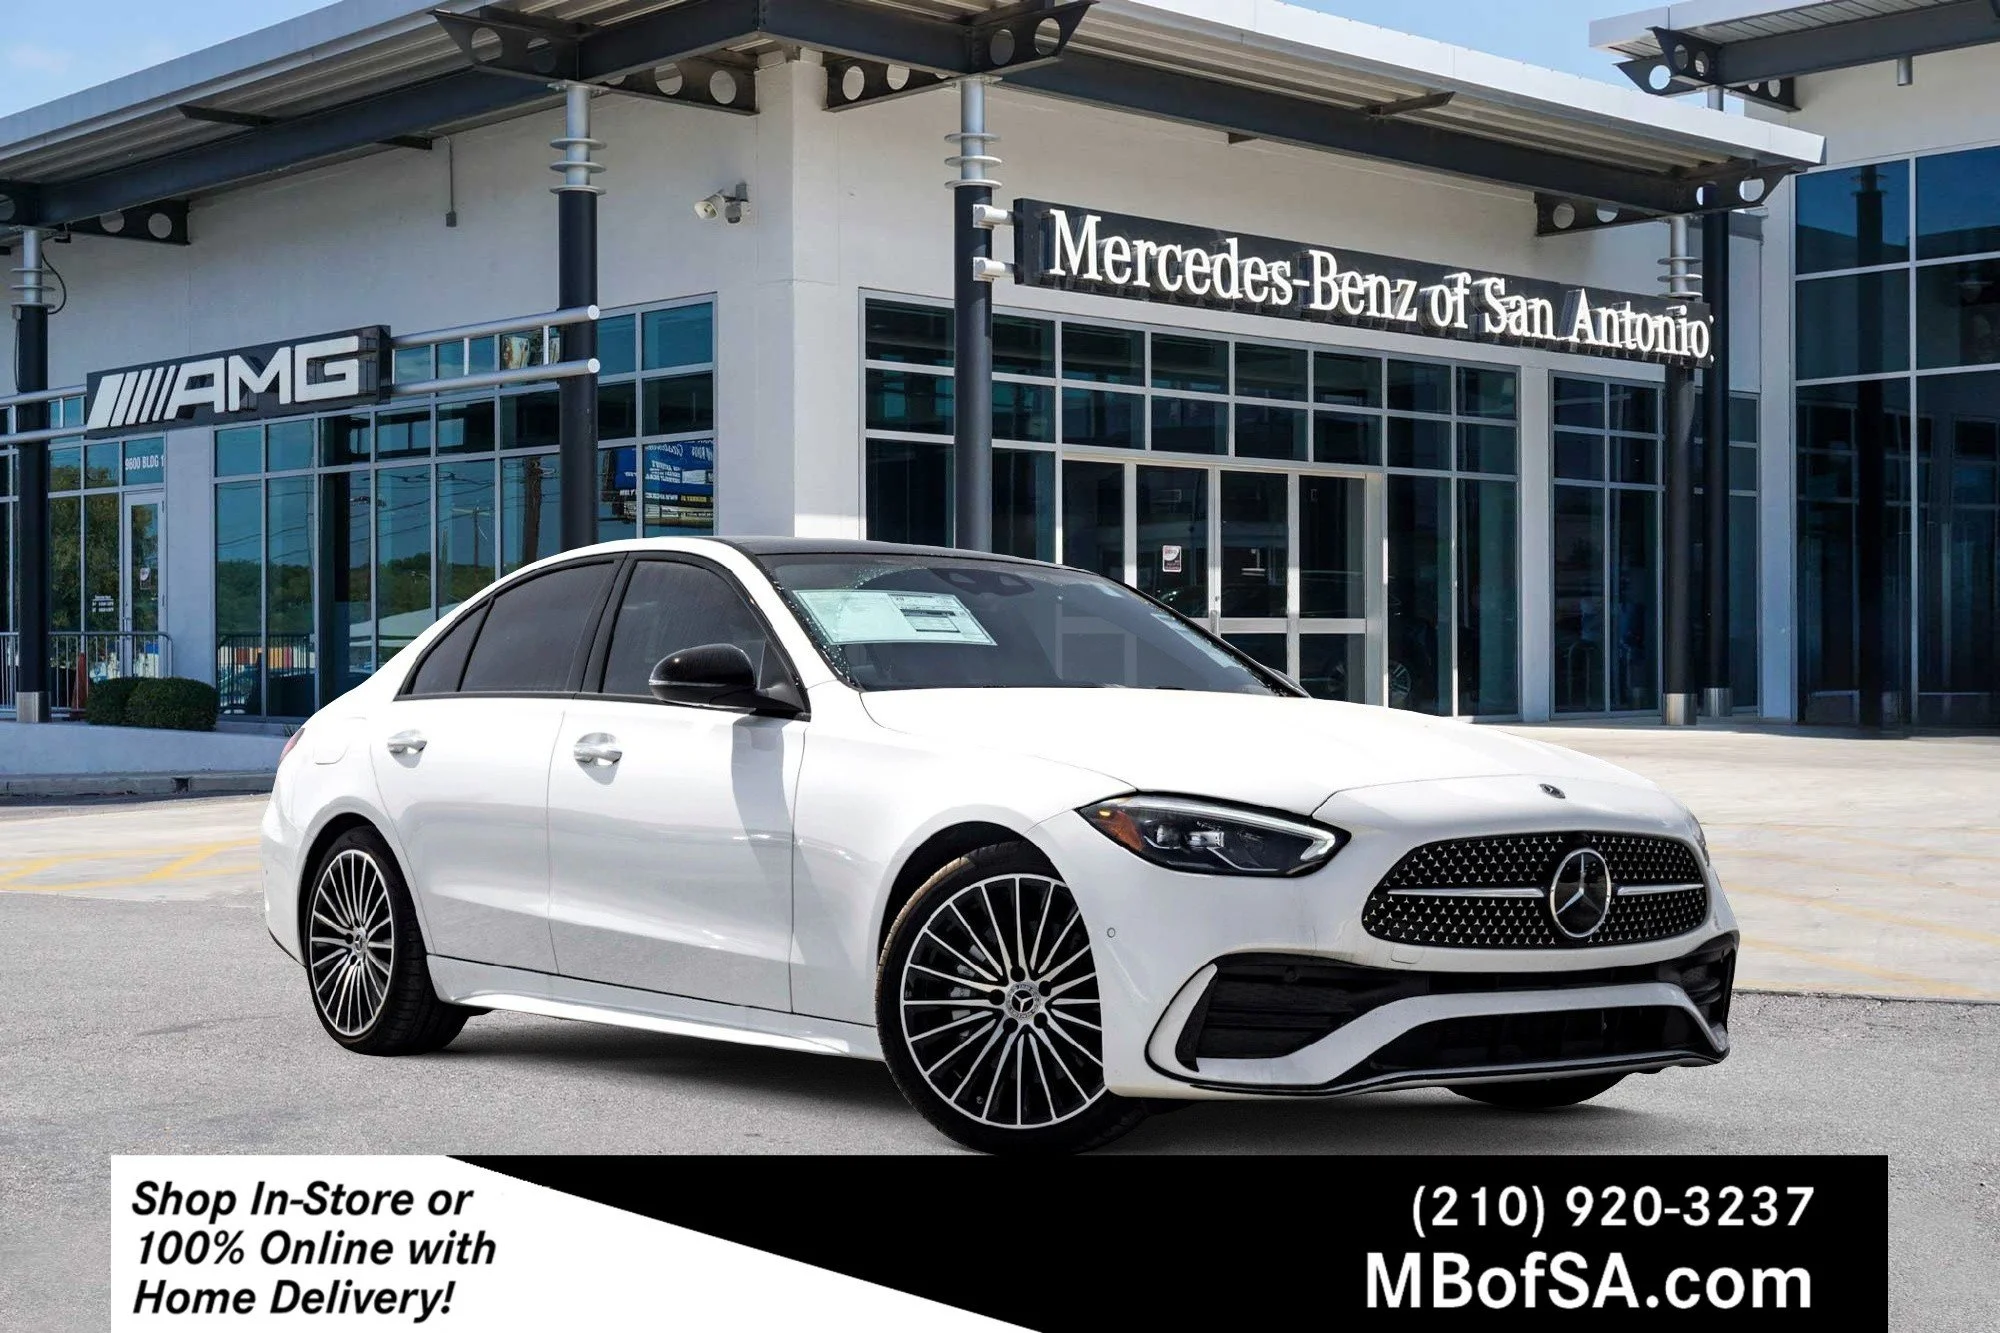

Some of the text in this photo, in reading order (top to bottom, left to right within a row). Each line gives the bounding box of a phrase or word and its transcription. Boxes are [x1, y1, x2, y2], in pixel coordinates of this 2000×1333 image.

[1049, 208, 1710, 359] Mercedes-Benz of San Antonio
[163, 335, 359, 420] AMG
